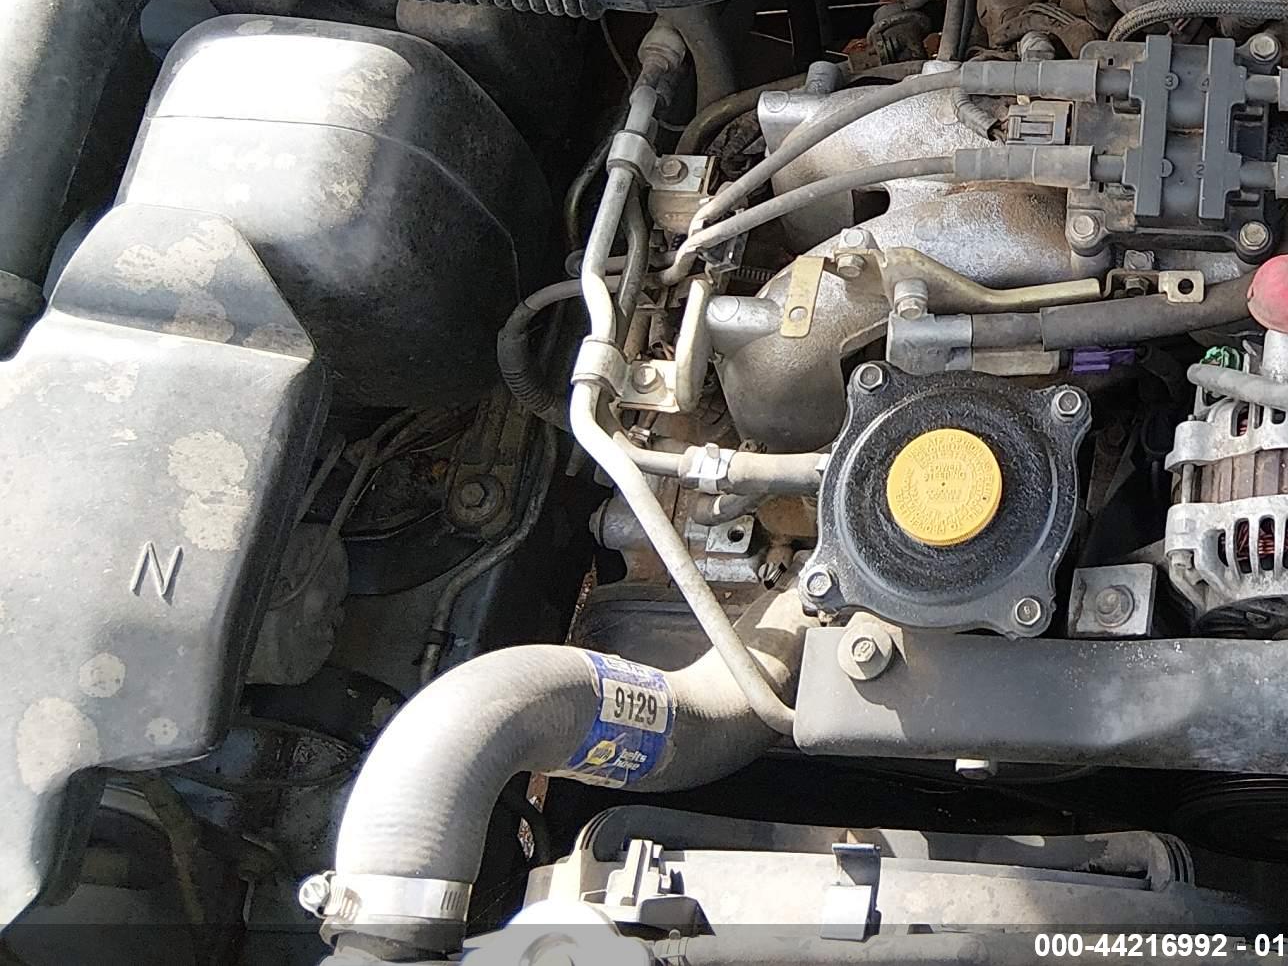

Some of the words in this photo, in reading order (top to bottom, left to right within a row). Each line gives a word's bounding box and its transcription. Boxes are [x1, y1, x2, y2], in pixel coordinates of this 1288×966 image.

[1165, 75, 1173, 87] 3
[1201, 77, 1210, 88] 4
[1196, 164, 1205, 175] 2
[129, 540, 184, 605] N
[613, 686, 657, 726] 9129
[619, 748, 648, 763] belts
